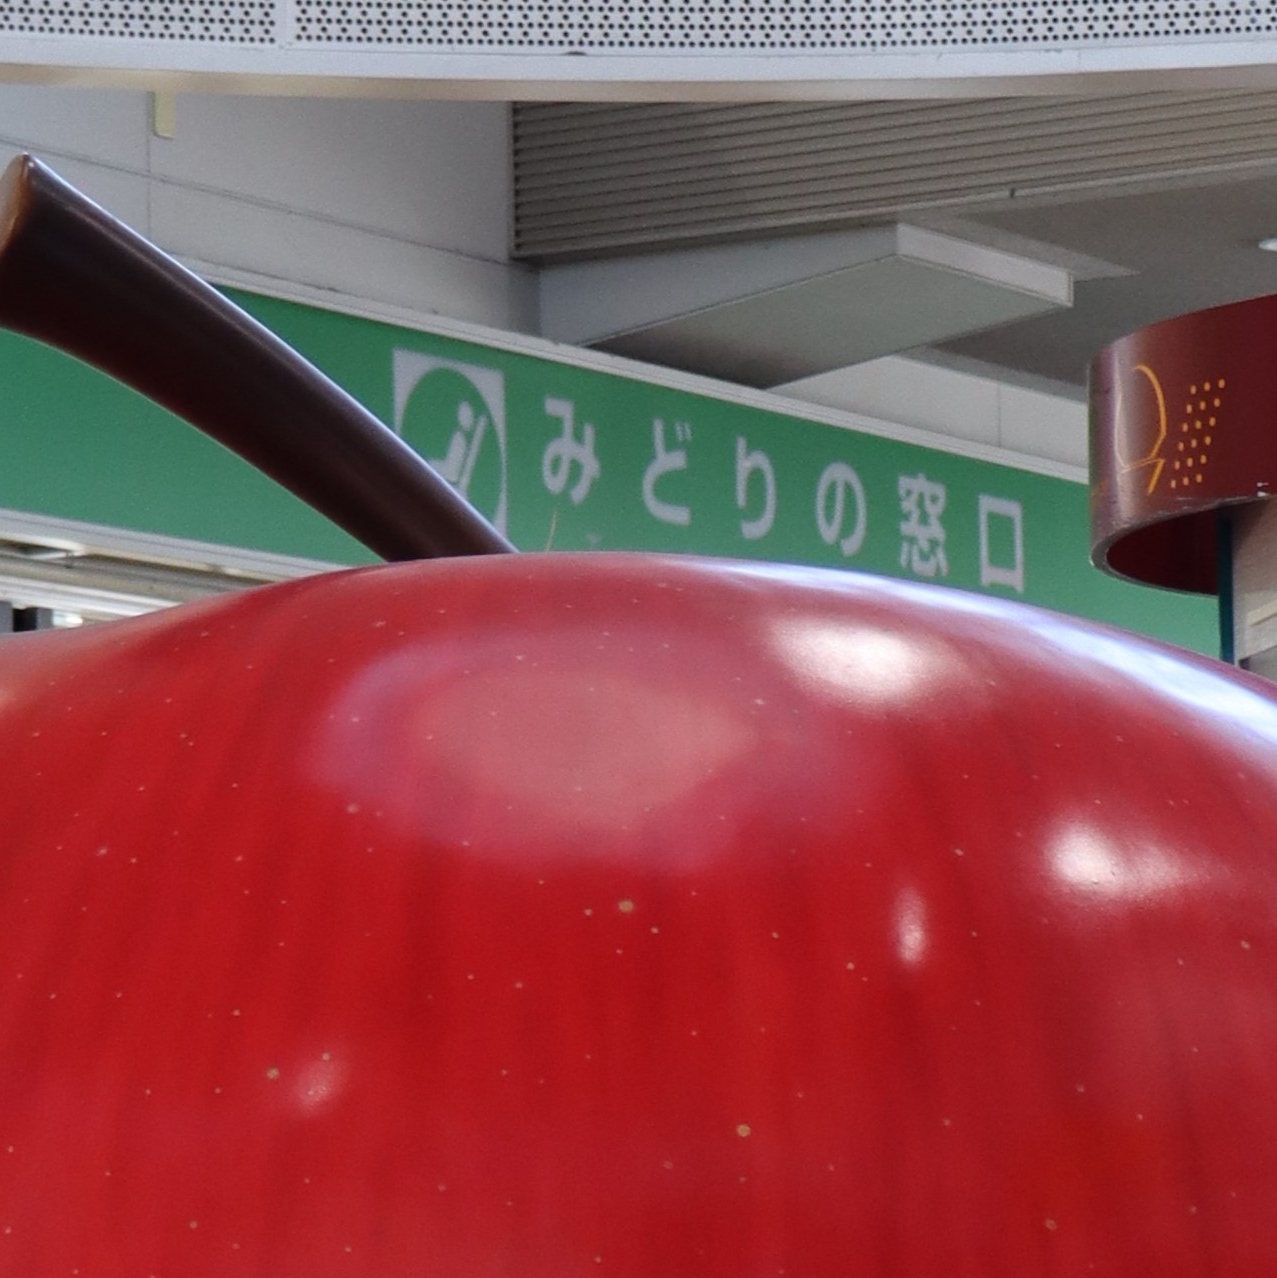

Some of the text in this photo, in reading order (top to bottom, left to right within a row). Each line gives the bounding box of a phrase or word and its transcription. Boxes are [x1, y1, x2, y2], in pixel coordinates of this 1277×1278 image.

[542, 396, 1025, 594] みどりの窓口
